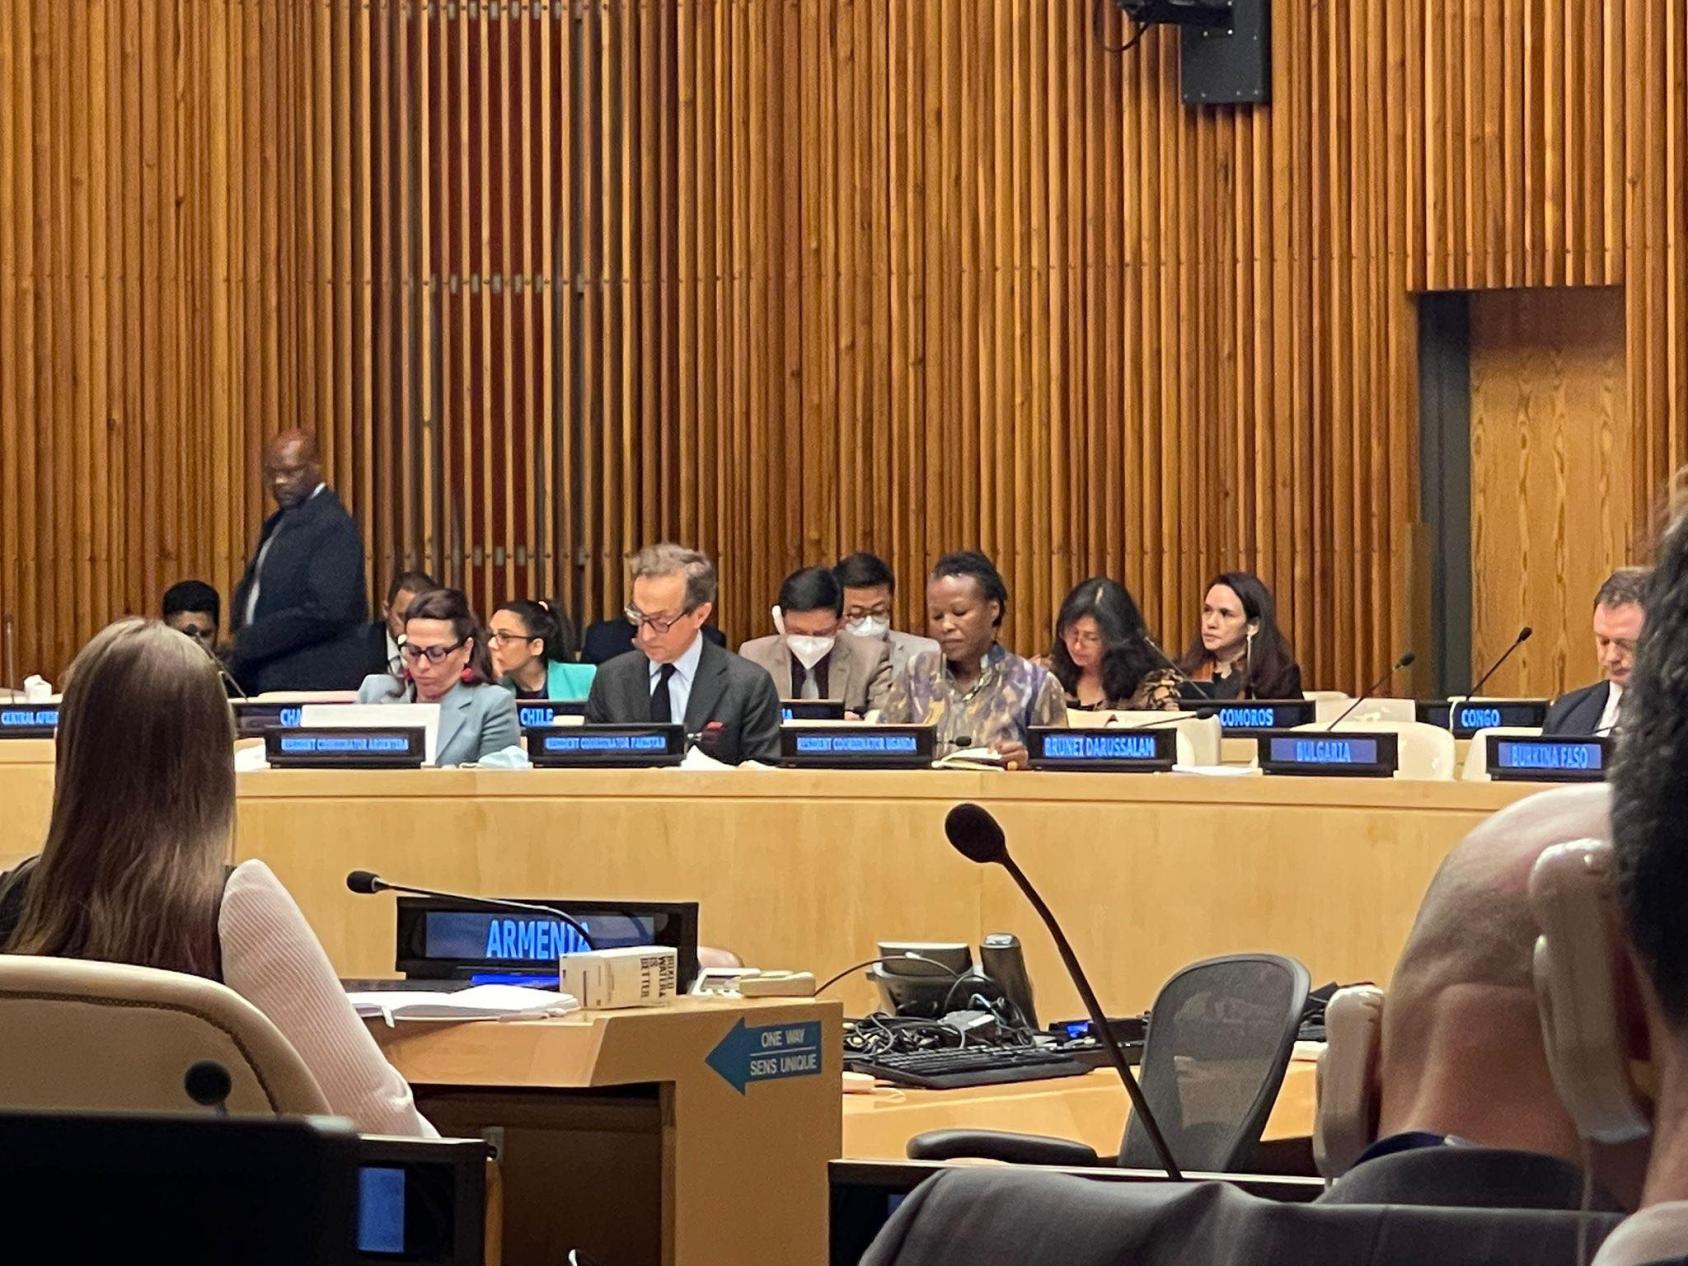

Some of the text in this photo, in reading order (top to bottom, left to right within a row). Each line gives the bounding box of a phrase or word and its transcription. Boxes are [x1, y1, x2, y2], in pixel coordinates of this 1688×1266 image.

[519, 707, 554, 726] CHILE
[1219, 708, 1274, 727] COMOROS
[1460, 708, 1501, 728] CONGO
[1045, 737, 1155, 757] BRUNEI DARUSSALAM
[1296, 742, 1352, 763] BULGARIA
[1511, 745, 1589, 768] BURKINA FASO
[761, 1028, 806, 1048] ONE WAY
[750, 1054, 817, 1076] SENS UNIQUE
